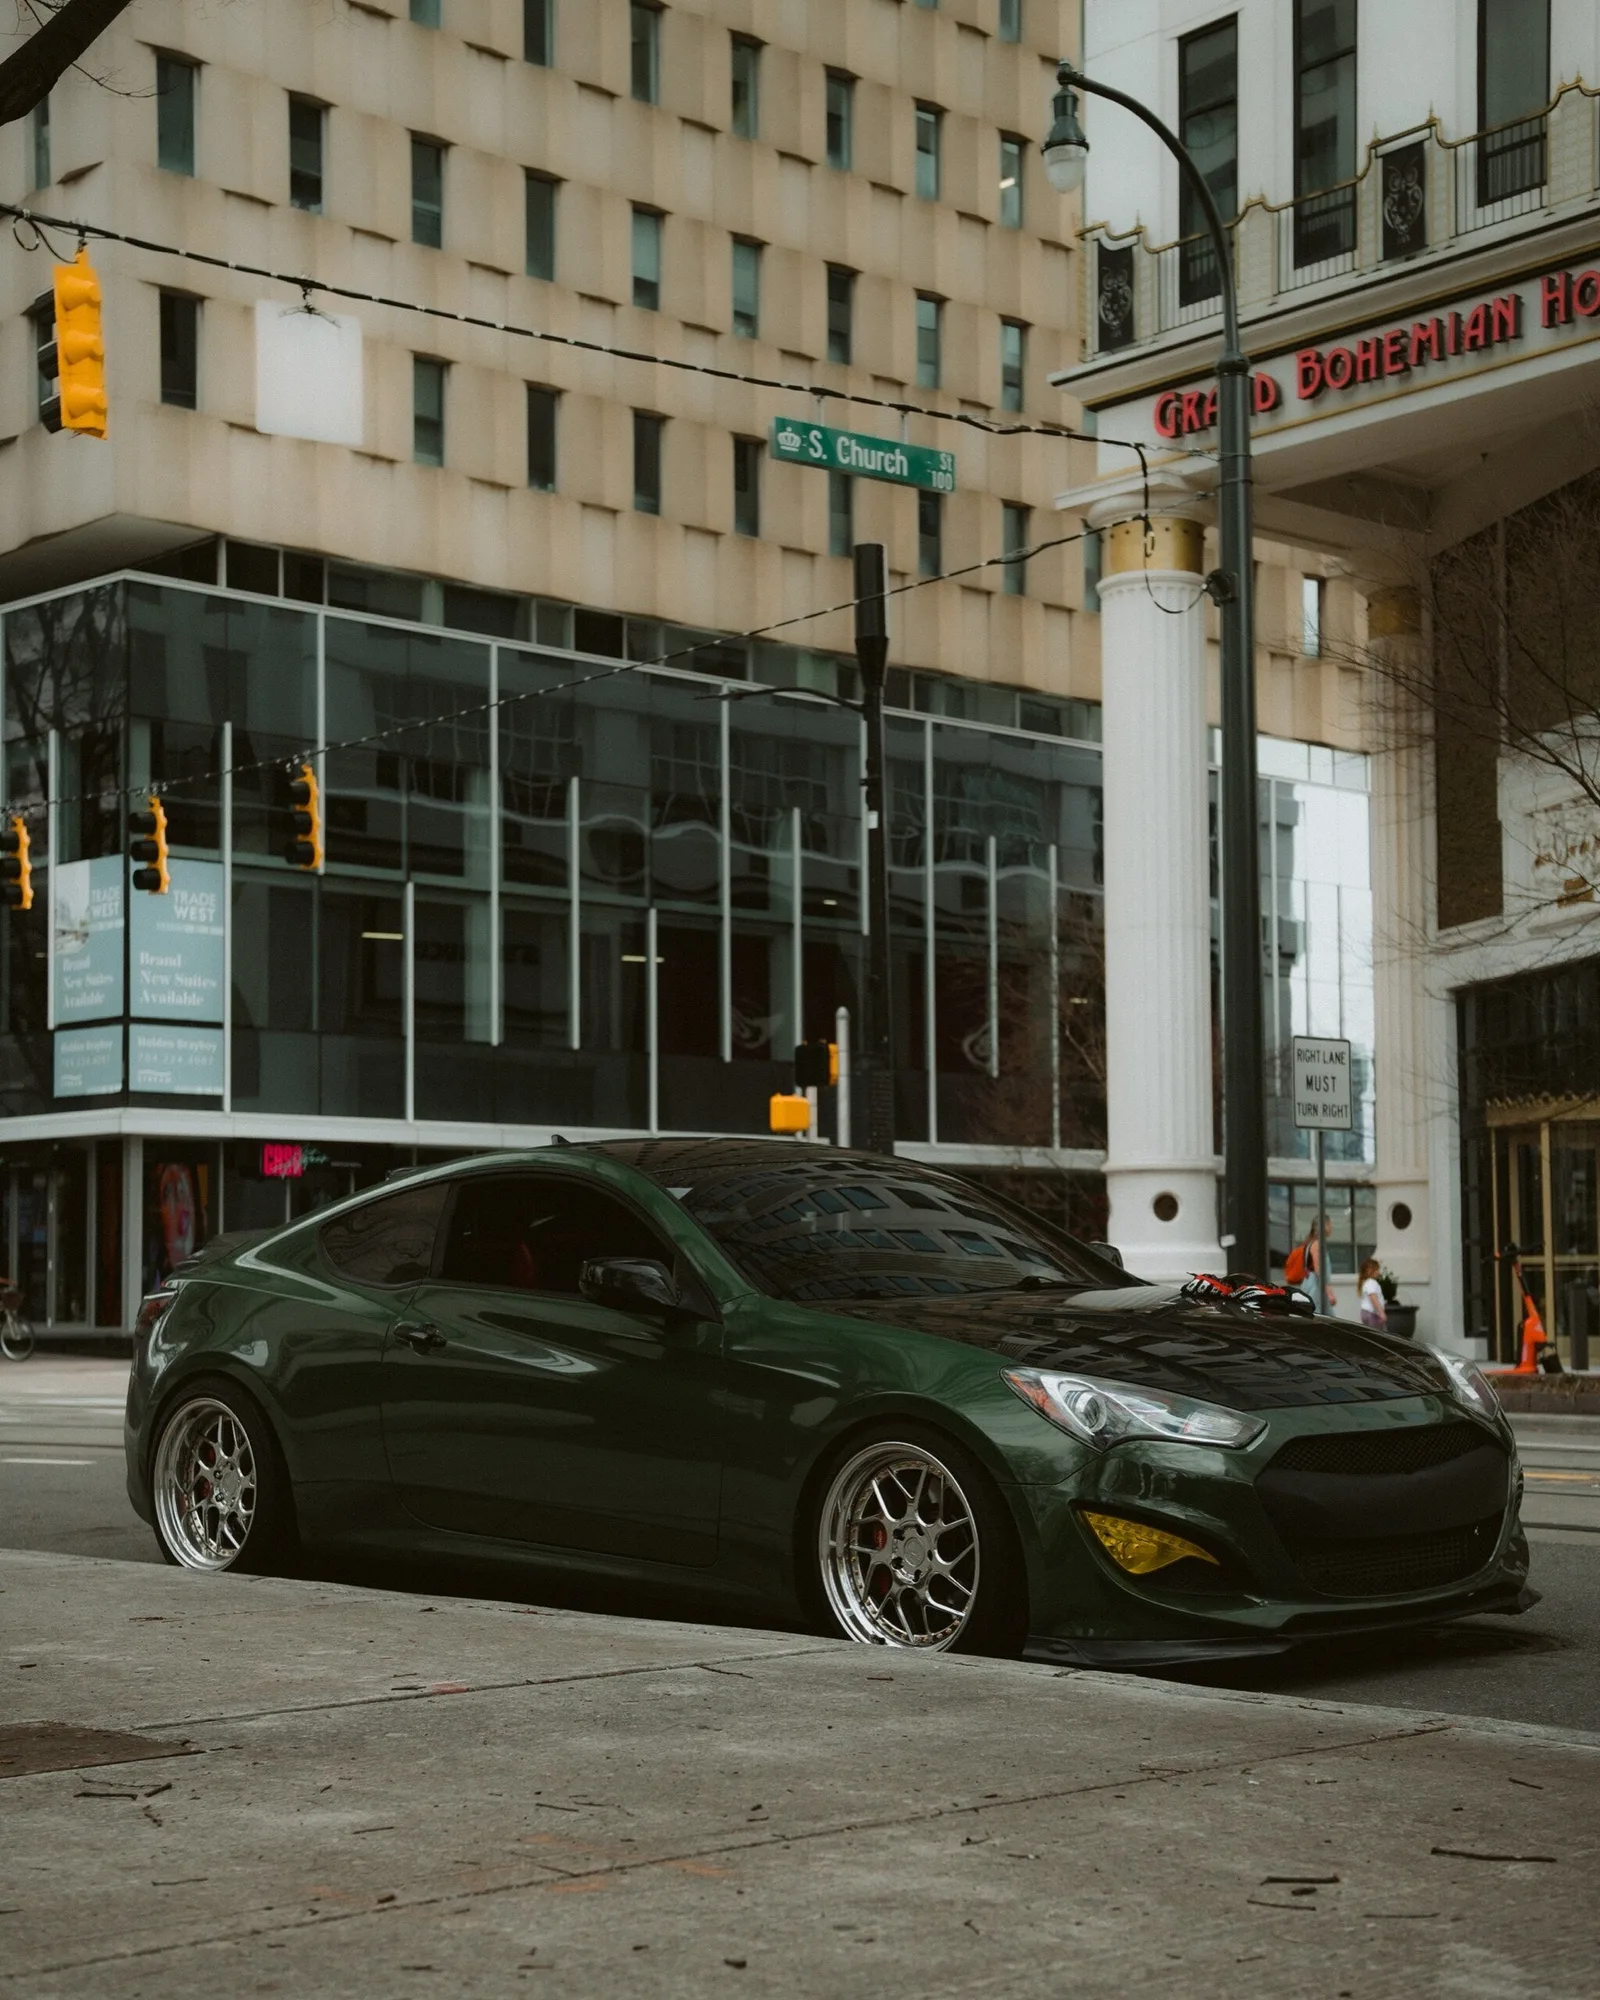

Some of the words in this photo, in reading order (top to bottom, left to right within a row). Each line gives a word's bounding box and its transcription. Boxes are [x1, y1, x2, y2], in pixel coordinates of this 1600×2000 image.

[1154, 371, 1278, 438] GRAD
[1296, 293, 1518, 400] BOHEMIAN
[808, 429, 828, 460] S.
[836, 436, 908, 477] Church
[939, 452, 953, 472] St
[932, 470, 953, 490] 100
[172, 890, 217, 906] TRADE
[173, 905, 216, 922] WEST
[141, 952, 182, 968] Brand
[141, 970, 170, 985] New
[175, 973, 217, 988] Suites
[140, 989, 205, 1006] Available
[1297, 1049, 1320, 1063] RIGHT
[1323, 1051, 1347, 1066] LANE
[1306, 1075, 1336, 1093] MUST
[1297, 1102, 1318, 1117] TURN
[1322, 1104, 1349, 1118] RIGHT
